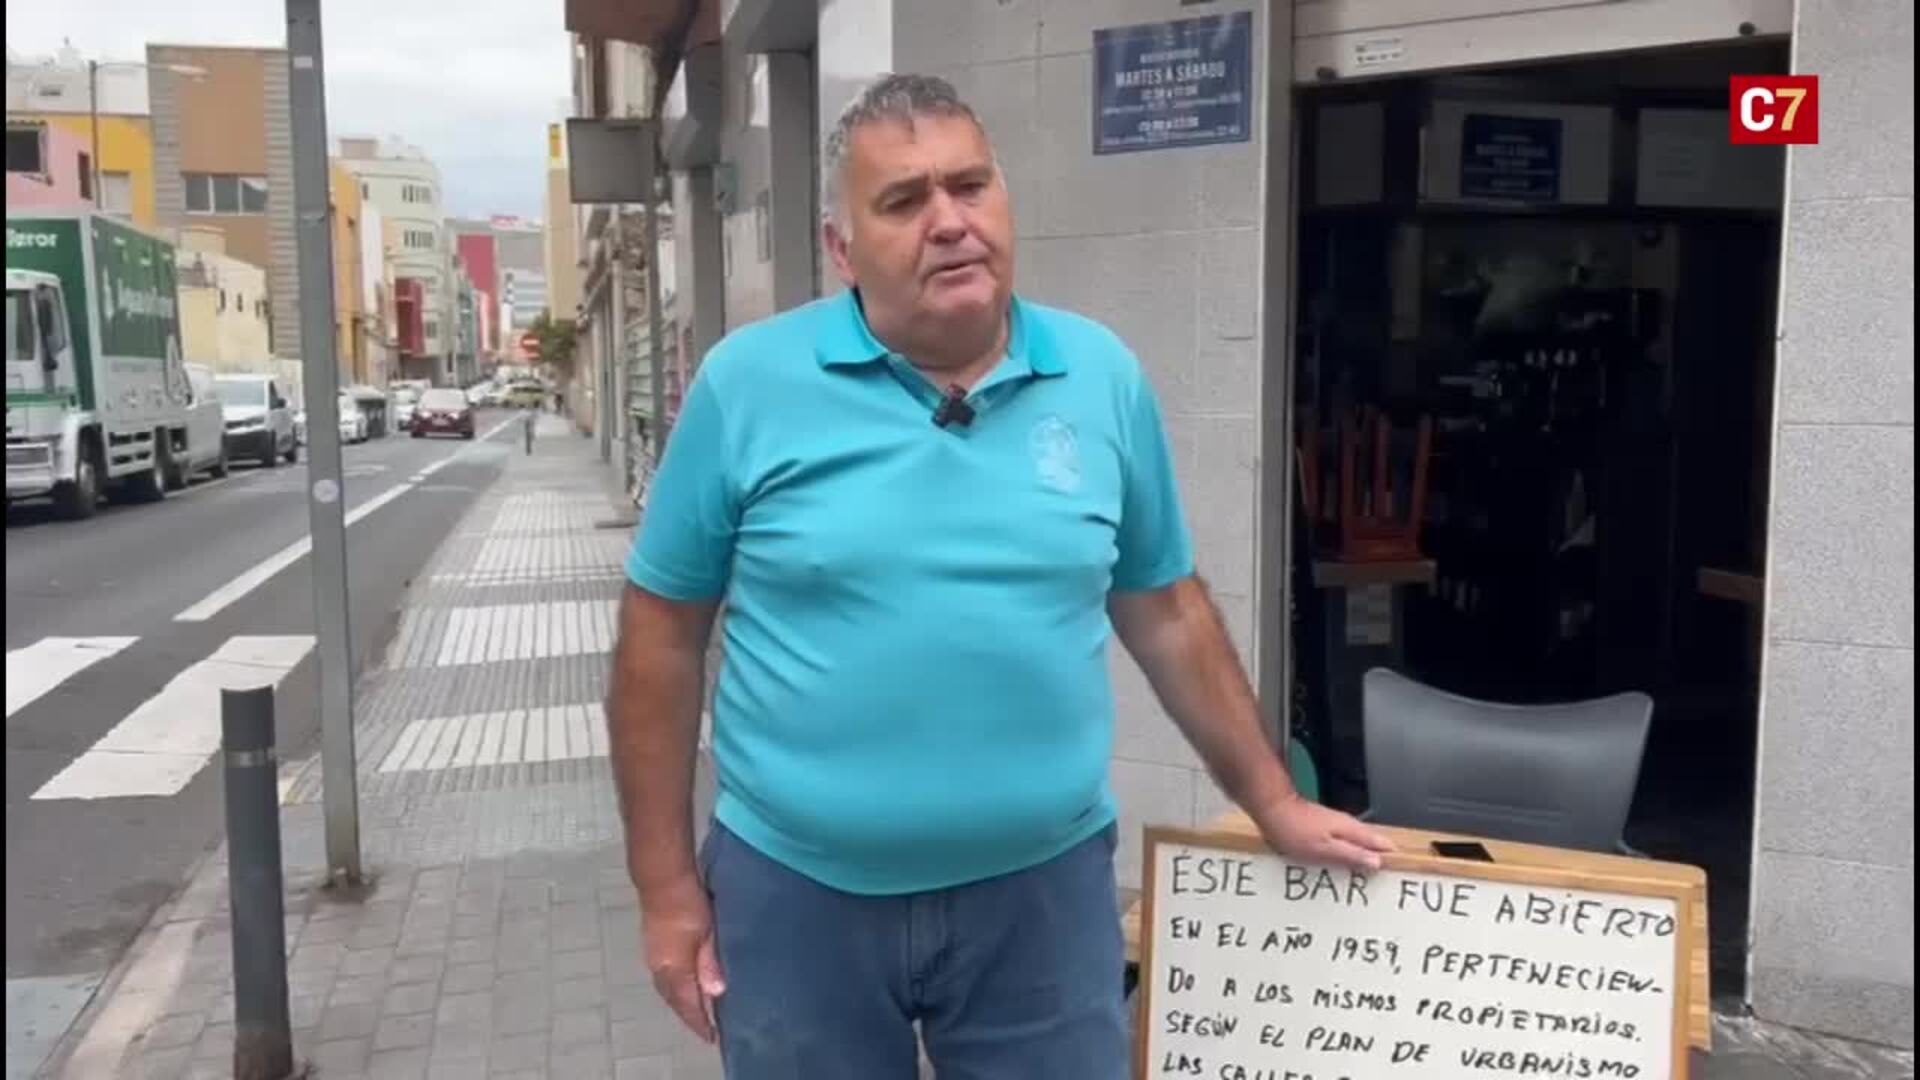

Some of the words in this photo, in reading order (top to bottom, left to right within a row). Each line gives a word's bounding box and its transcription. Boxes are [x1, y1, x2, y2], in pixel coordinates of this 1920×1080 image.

[1166, 67, 1173, 82] A
[1283, 865, 1369, 906] BAR
[1398, 880, 1476, 916] FUE
[1170, 916, 1201, 938] EN
[1217, 923, 1247, 948] EL
[1261, 926, 1313, 954] AÑO
[1222, 978, 1237, 997] A
[1254, 982, 1294, 1003] LOS
[1260, 1024, 1286, 1048] EL
[1305, 1026, 1375, 1052] PLAN
[1391, 1041, 1430, 1063] DE
[1162, 1051, 1203, 1075] LAS
